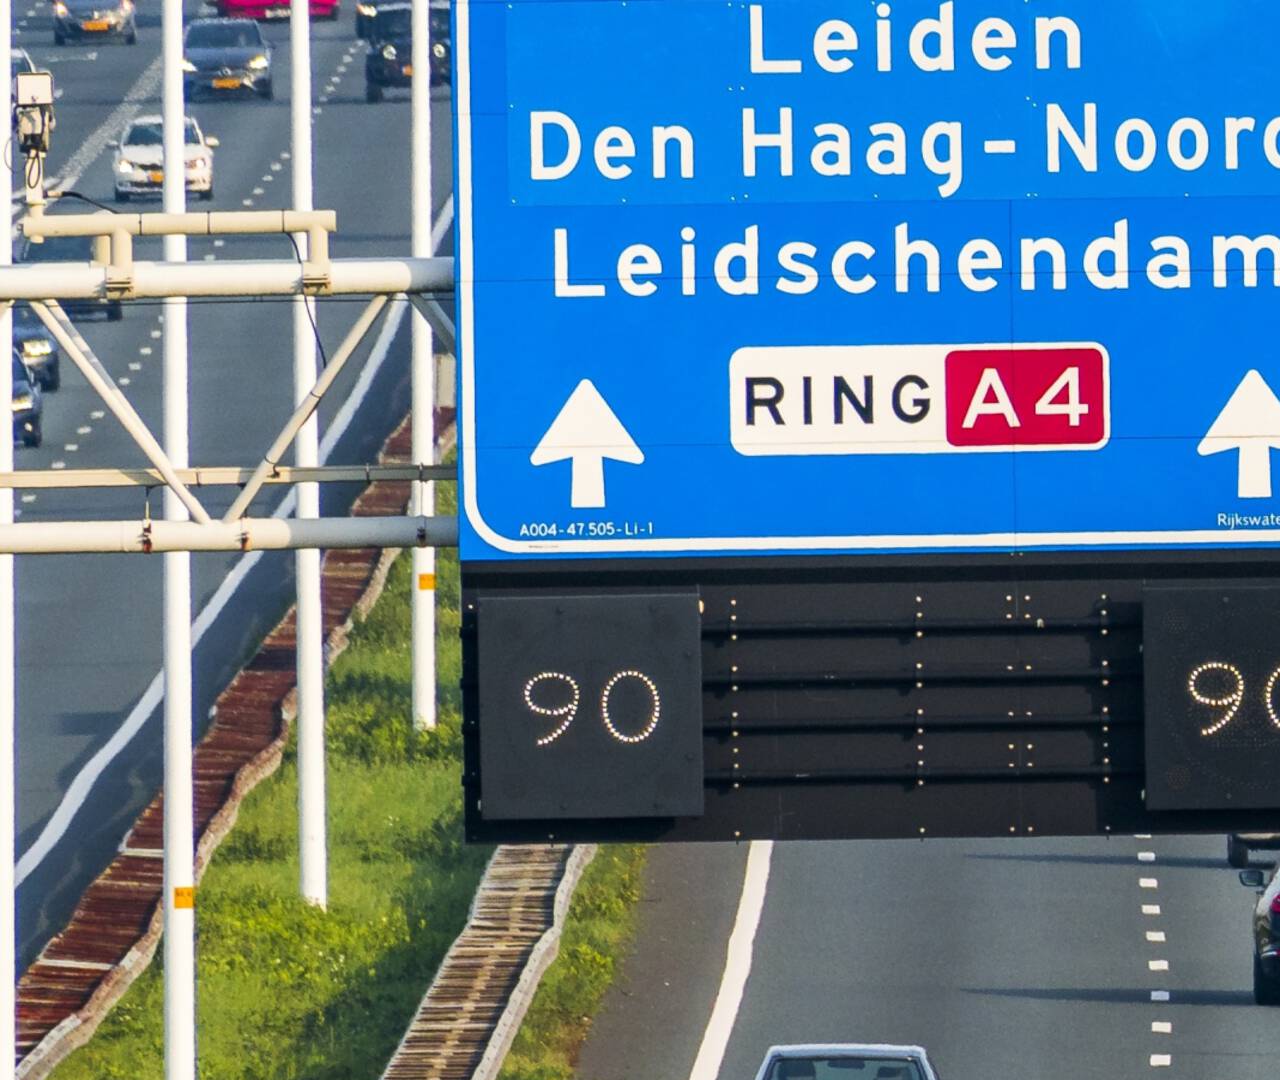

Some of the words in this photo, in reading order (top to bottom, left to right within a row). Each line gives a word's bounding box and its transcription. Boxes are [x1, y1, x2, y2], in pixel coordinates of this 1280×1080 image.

[749, 1, 1083, 74] Leiden
[530, 111, 694, 182] Den
[745, 374, 931, 427] RING
[962, 366, 1089, 430] A4
[523, 670, 661, 746] 90
